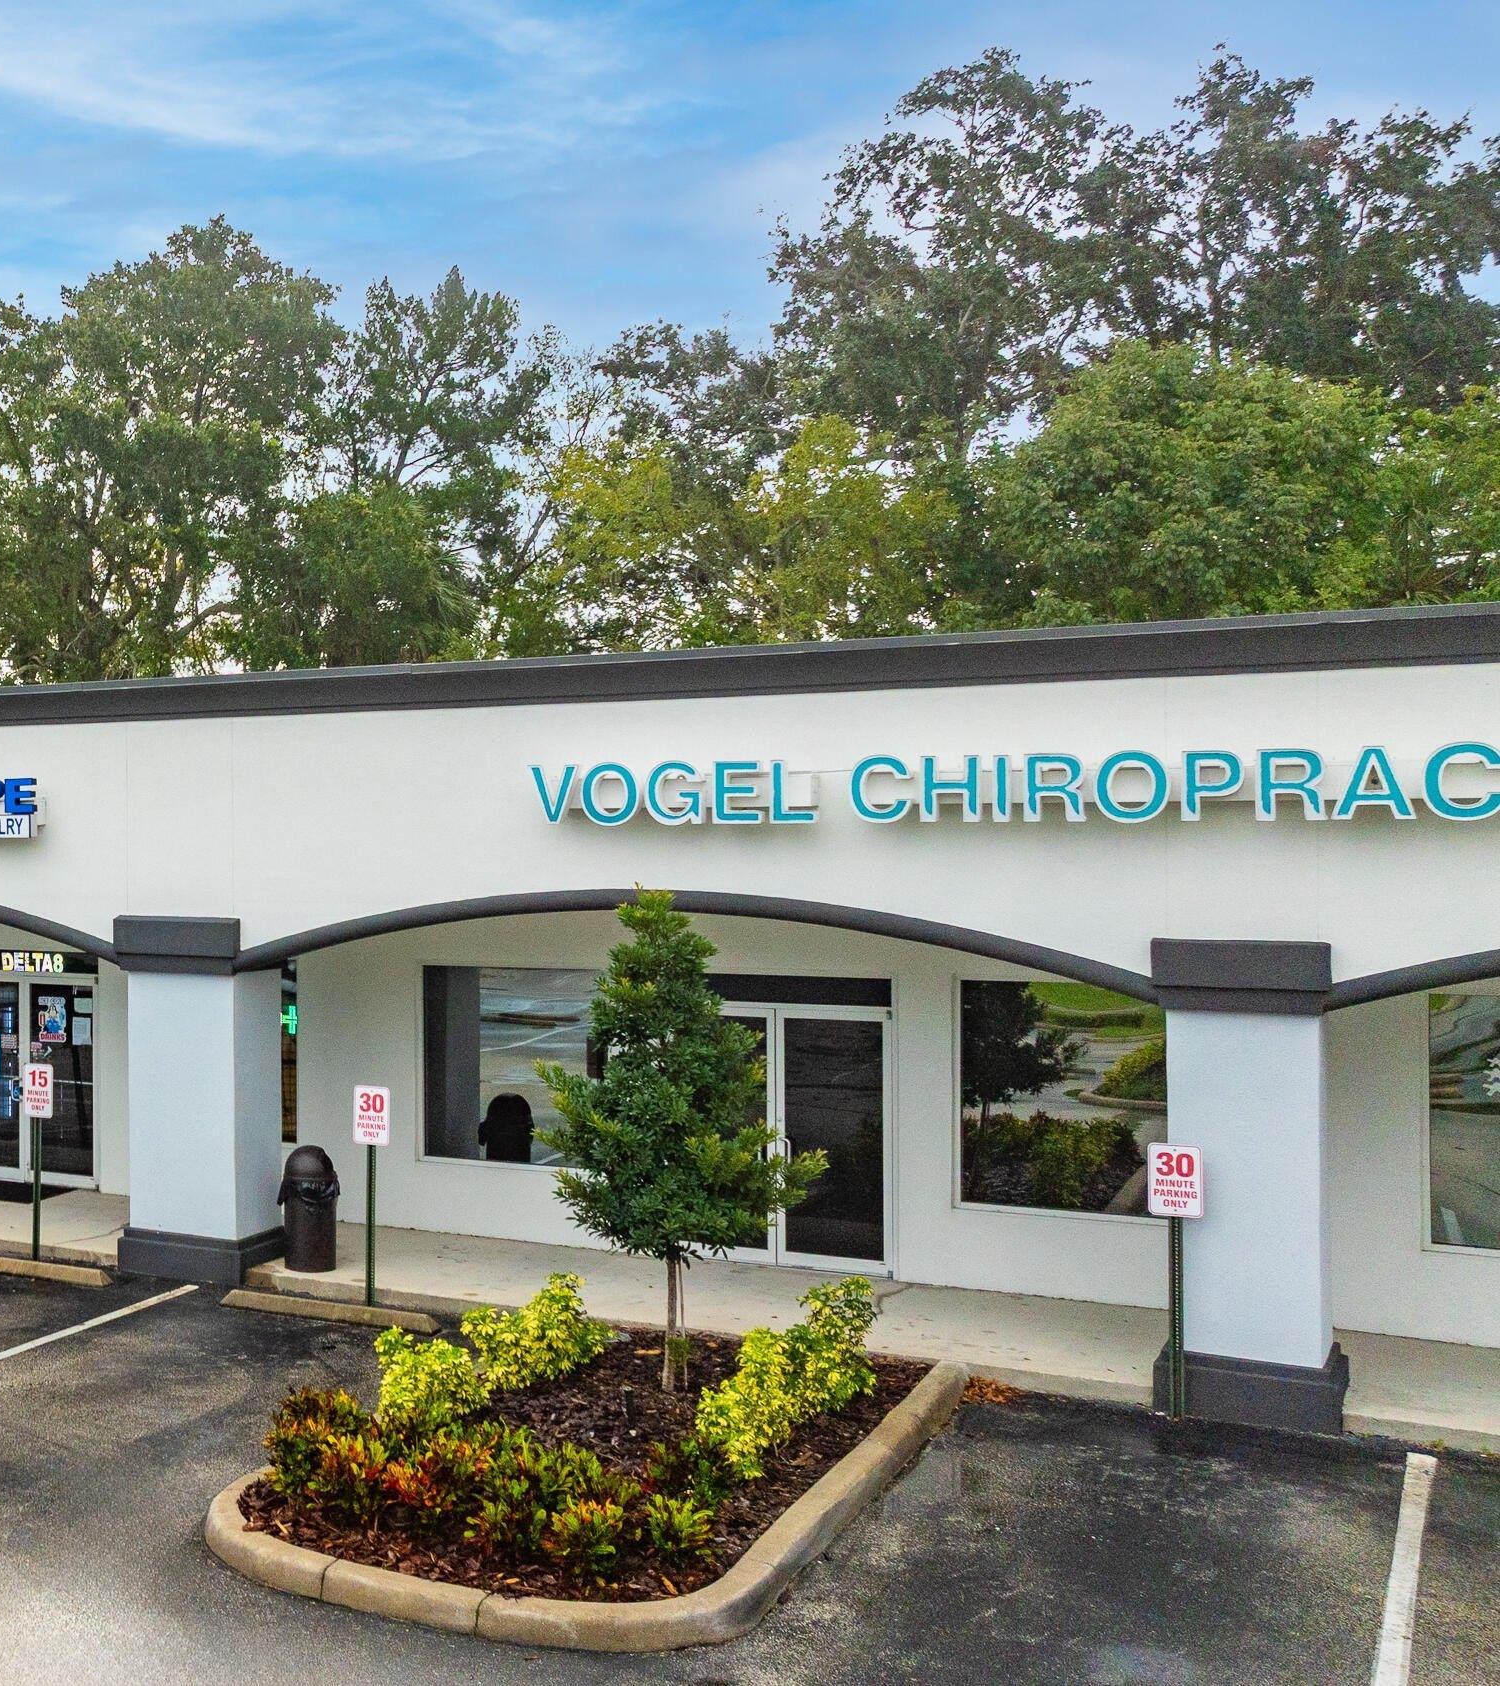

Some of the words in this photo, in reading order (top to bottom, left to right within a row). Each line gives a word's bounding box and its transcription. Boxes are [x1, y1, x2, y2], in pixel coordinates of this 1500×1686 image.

[528, 760, 818, 827] VOGEL
[850, 741, 1500, 825] CHIROPRAC
[1, 952, 64, 973] DELTA8
[40, 1033, 65, 1041] DRINKS
[29, 1070, 48, 1087] 15
[359, 1093, 384, 1113] 30
[358, 1114, 384, 1122] MINUTE
[357, 1122, 386, 1130] PARKING
[1156, 1152, 1195, 1178] 30
[1155, 1179, 1196, 1189] MINUTE
[1153, 1188, 1198, 1200] PARKING
[1163, 1199, 1188, 1208] ONLY
